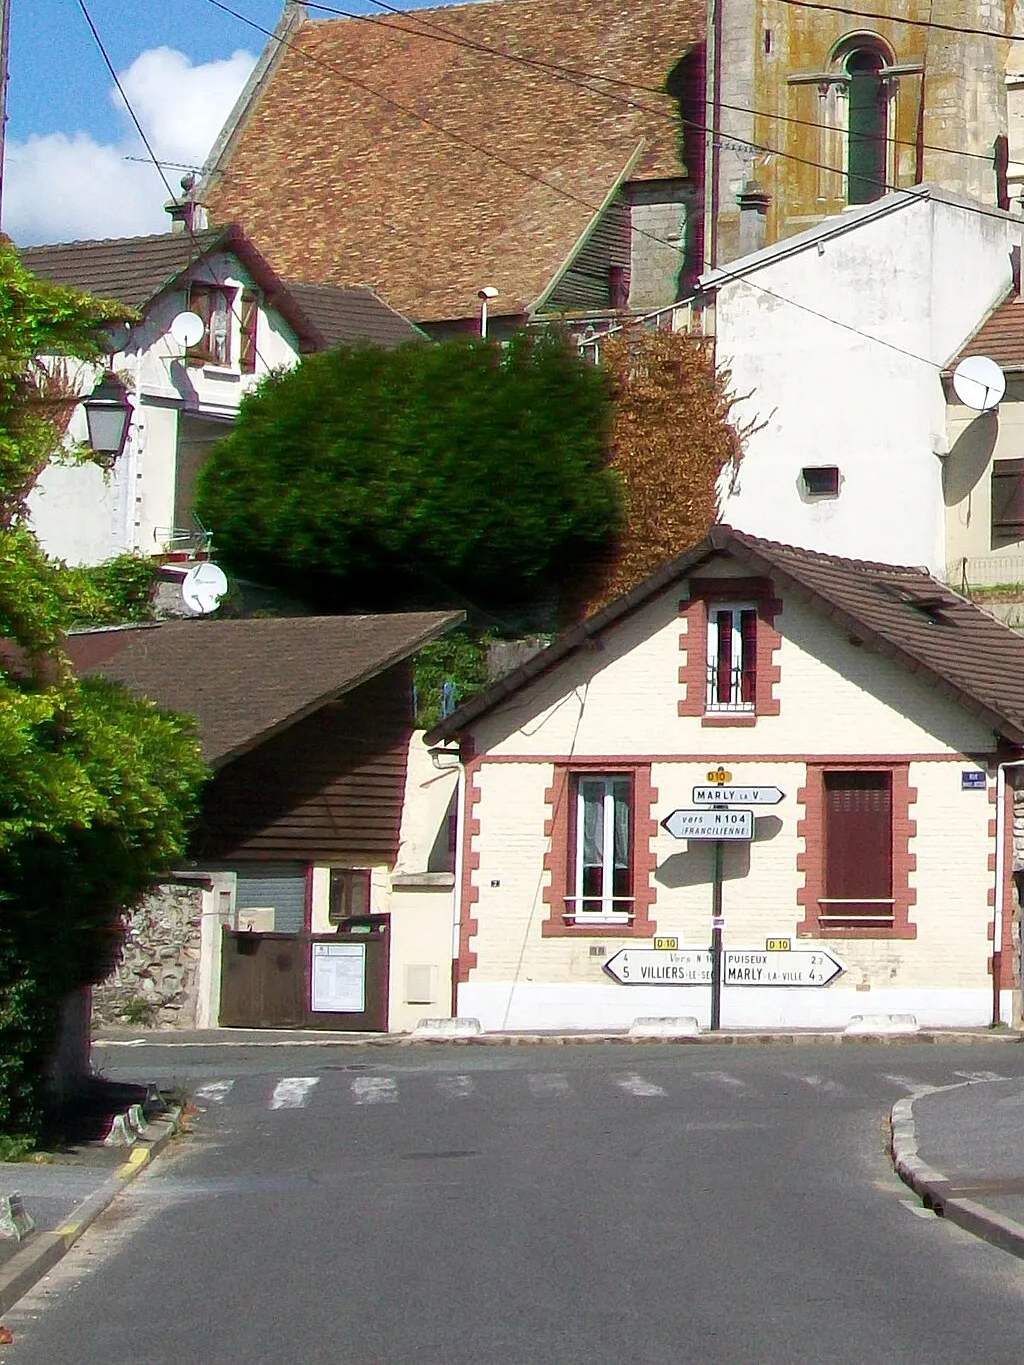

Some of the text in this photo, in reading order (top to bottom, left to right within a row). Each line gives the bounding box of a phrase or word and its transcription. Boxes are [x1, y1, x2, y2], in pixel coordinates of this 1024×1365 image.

[697, 791, 735, 800] MARLY
[682, 816, 703, 824] vers
[623, 954, 628, 962] 4
[670, 954, 690, 963] Vers
[728, 955, 767, 964] PUISEUX
[623, 966, 630, 978] 5
